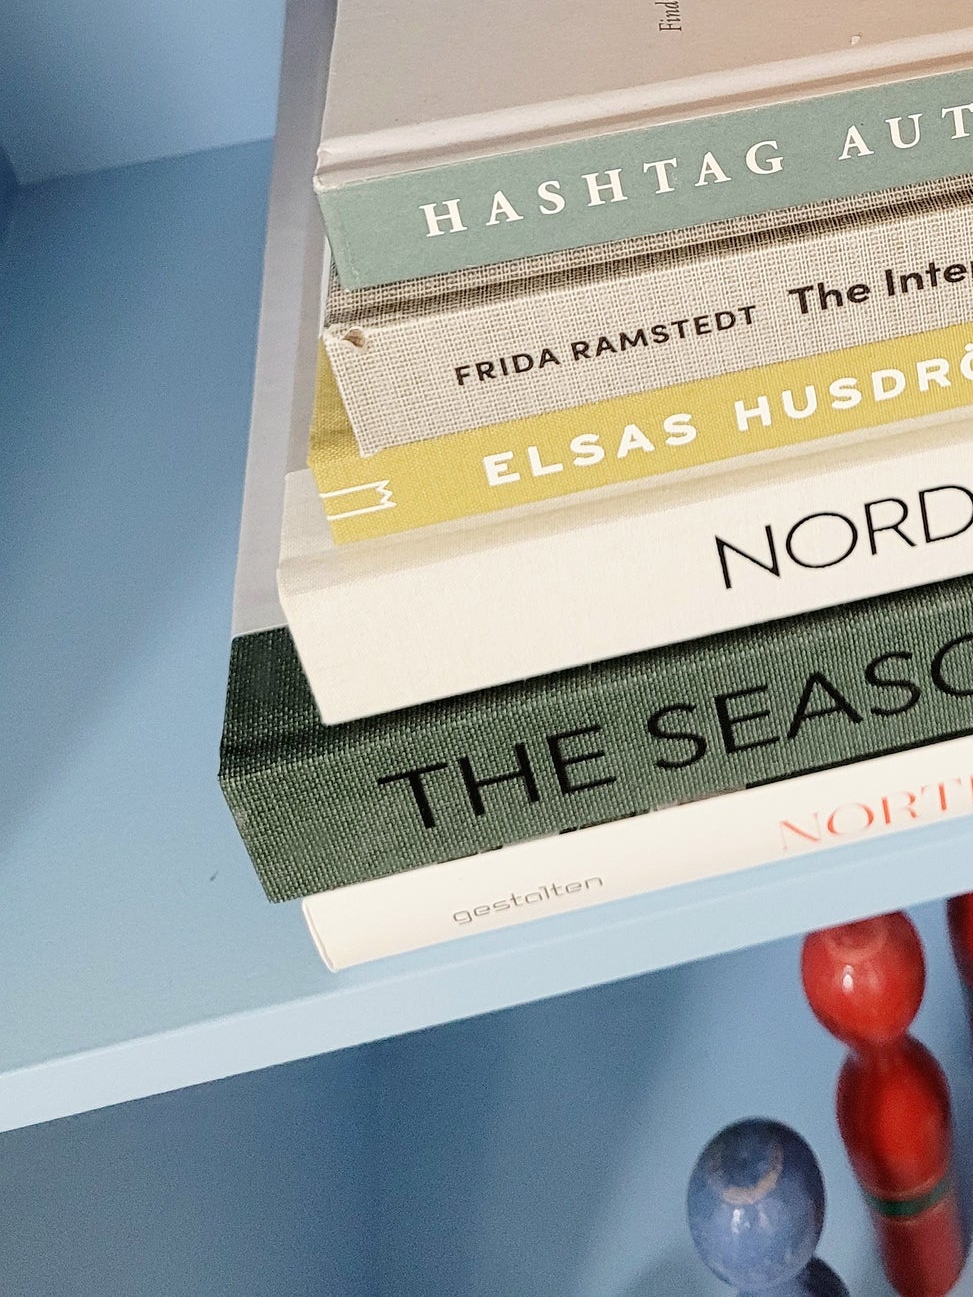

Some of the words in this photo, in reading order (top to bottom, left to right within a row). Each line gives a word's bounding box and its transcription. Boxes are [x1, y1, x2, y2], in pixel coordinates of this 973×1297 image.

[418, 138, 784, 239] HASHTAG
[787, 282, 871, 316] The
[454, 346, 561, 386] FRIDA
[571, 304, 757, 358] RAMSTEDT
[482, 413, 698, 488] ELSAS
[376, 724, 617, 830] THE
[452, 873, 604, 926] gestalten
